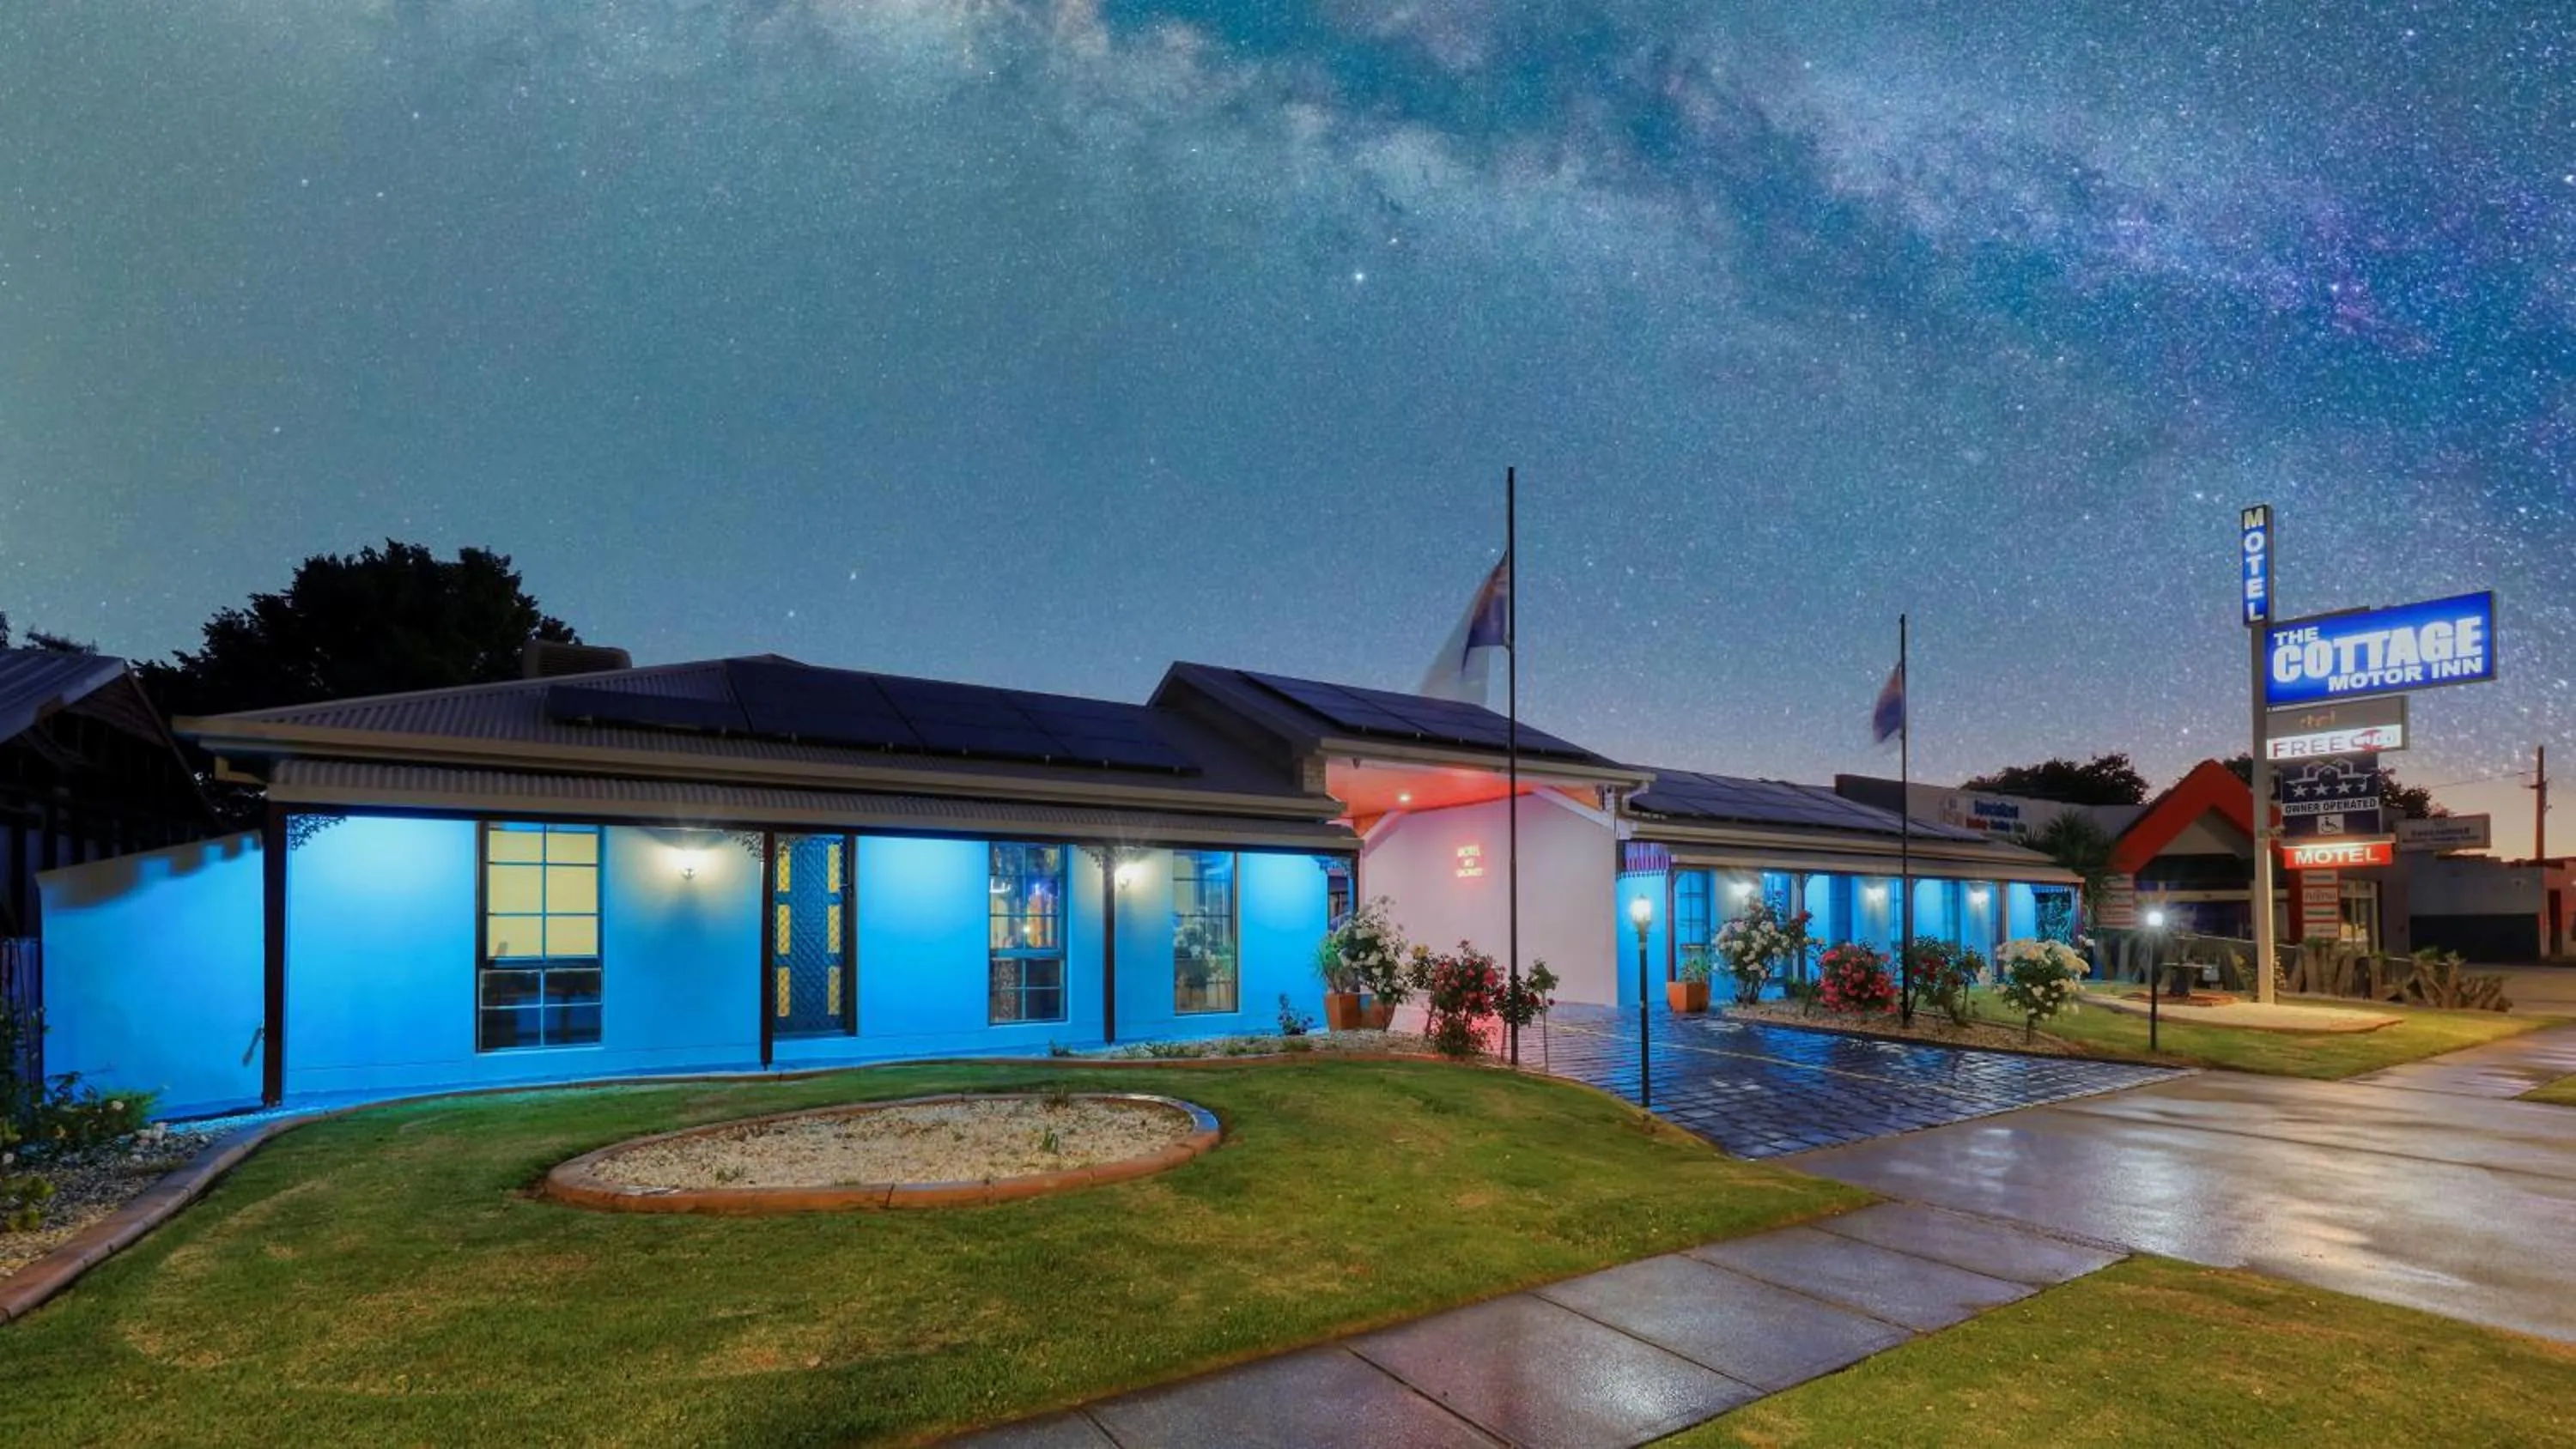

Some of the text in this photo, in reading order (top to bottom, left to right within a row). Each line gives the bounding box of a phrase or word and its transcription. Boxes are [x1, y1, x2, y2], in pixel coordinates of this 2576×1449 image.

[2244, 507, 2264, 621] MOTEL
[2274, 627, 2318, 646] THE
[2273, 616, 2482, 682] COTTAGE
[2328, 658, 2483, 692] MOTOR INN
[2272, 736, 2343, 757] FREE
[2285, 797, 2378, 814] OWNER OPERATED
[2294, 846, 2380, 865] MOTEL
